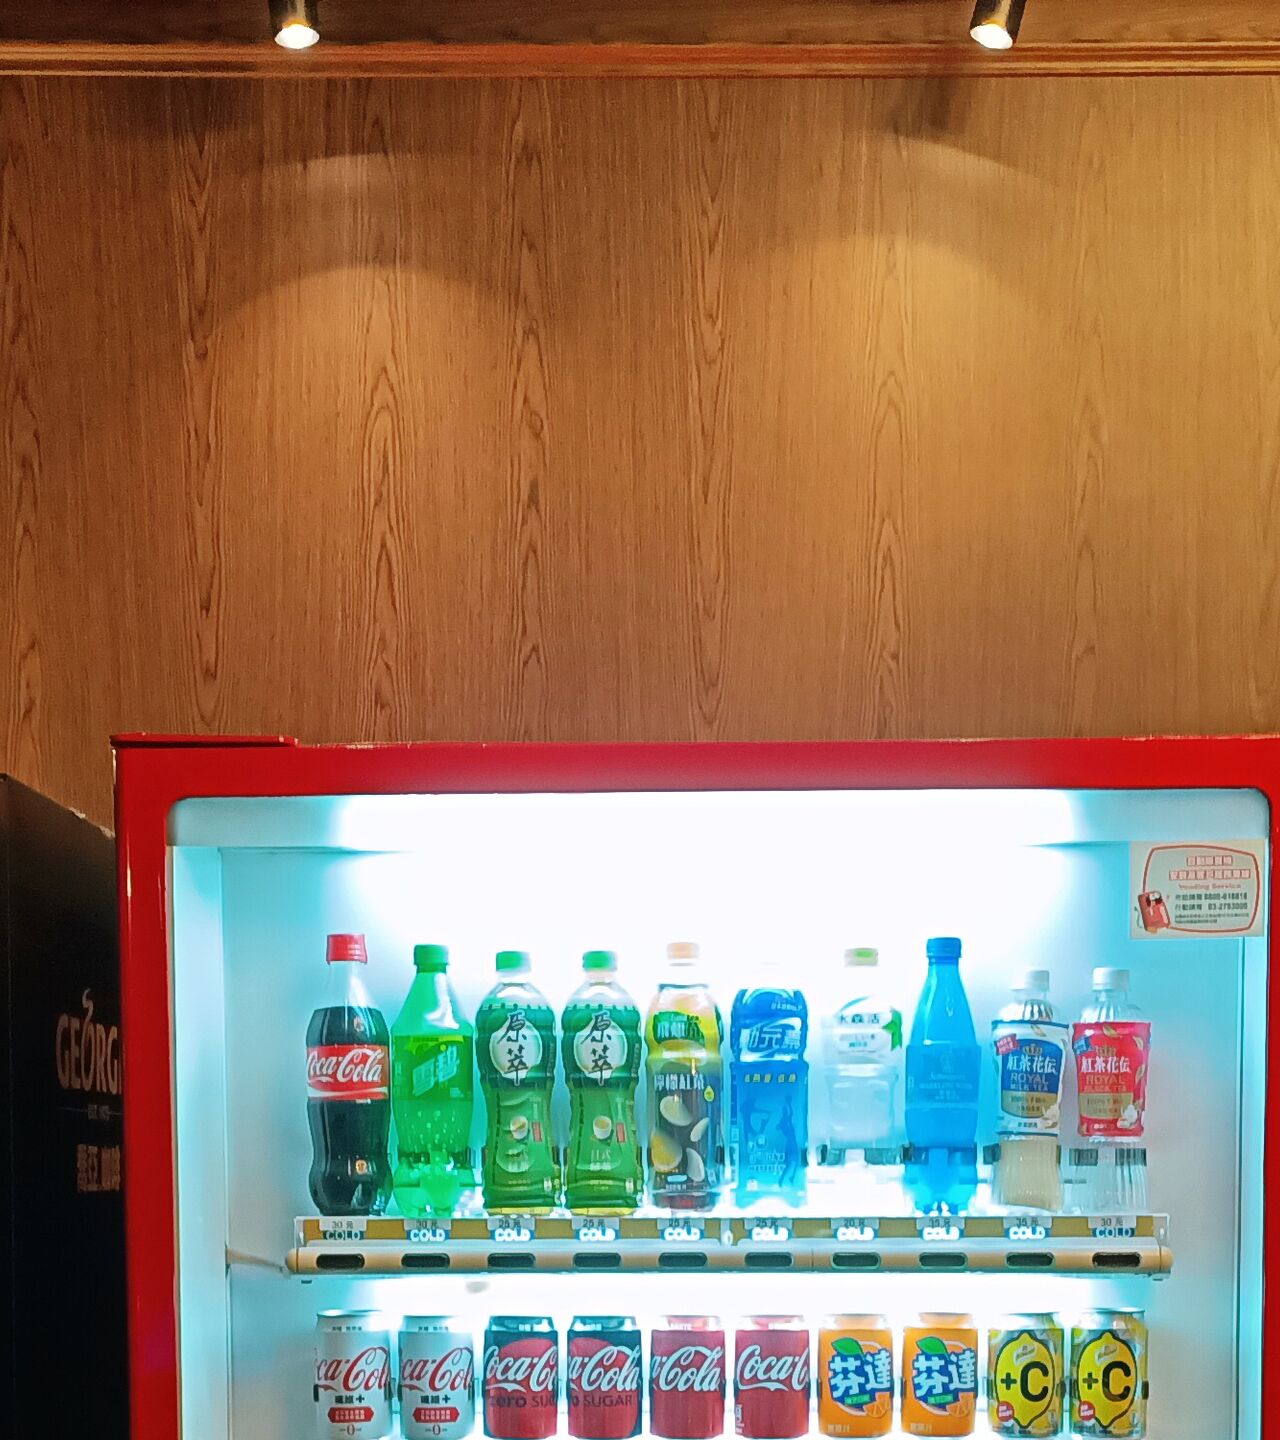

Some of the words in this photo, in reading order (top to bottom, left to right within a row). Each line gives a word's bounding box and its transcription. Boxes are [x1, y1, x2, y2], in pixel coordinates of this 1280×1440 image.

[56, 988, 121, 1095] GEORG
[499, 1010, 528, 1087] 原萃
[581, 1011, 613, 1087] 原萃
[307, 1048, 385, 1083] Coca-Cola
[1011, 1072, 1049, 1084] ROYAL
[1086, 1074, 1125, 1085] ROYAL
[410, 1228, 446, 1241] COLD
[494, 1228, 531, 1241] COLD
[1008, 1227, 1045, 1240] COLD
[830, 1349, 893, 1397] 芬達
[913, 1349, 976, 1397] 芬達
[583, 1394, 633, 1407] SUGAR
